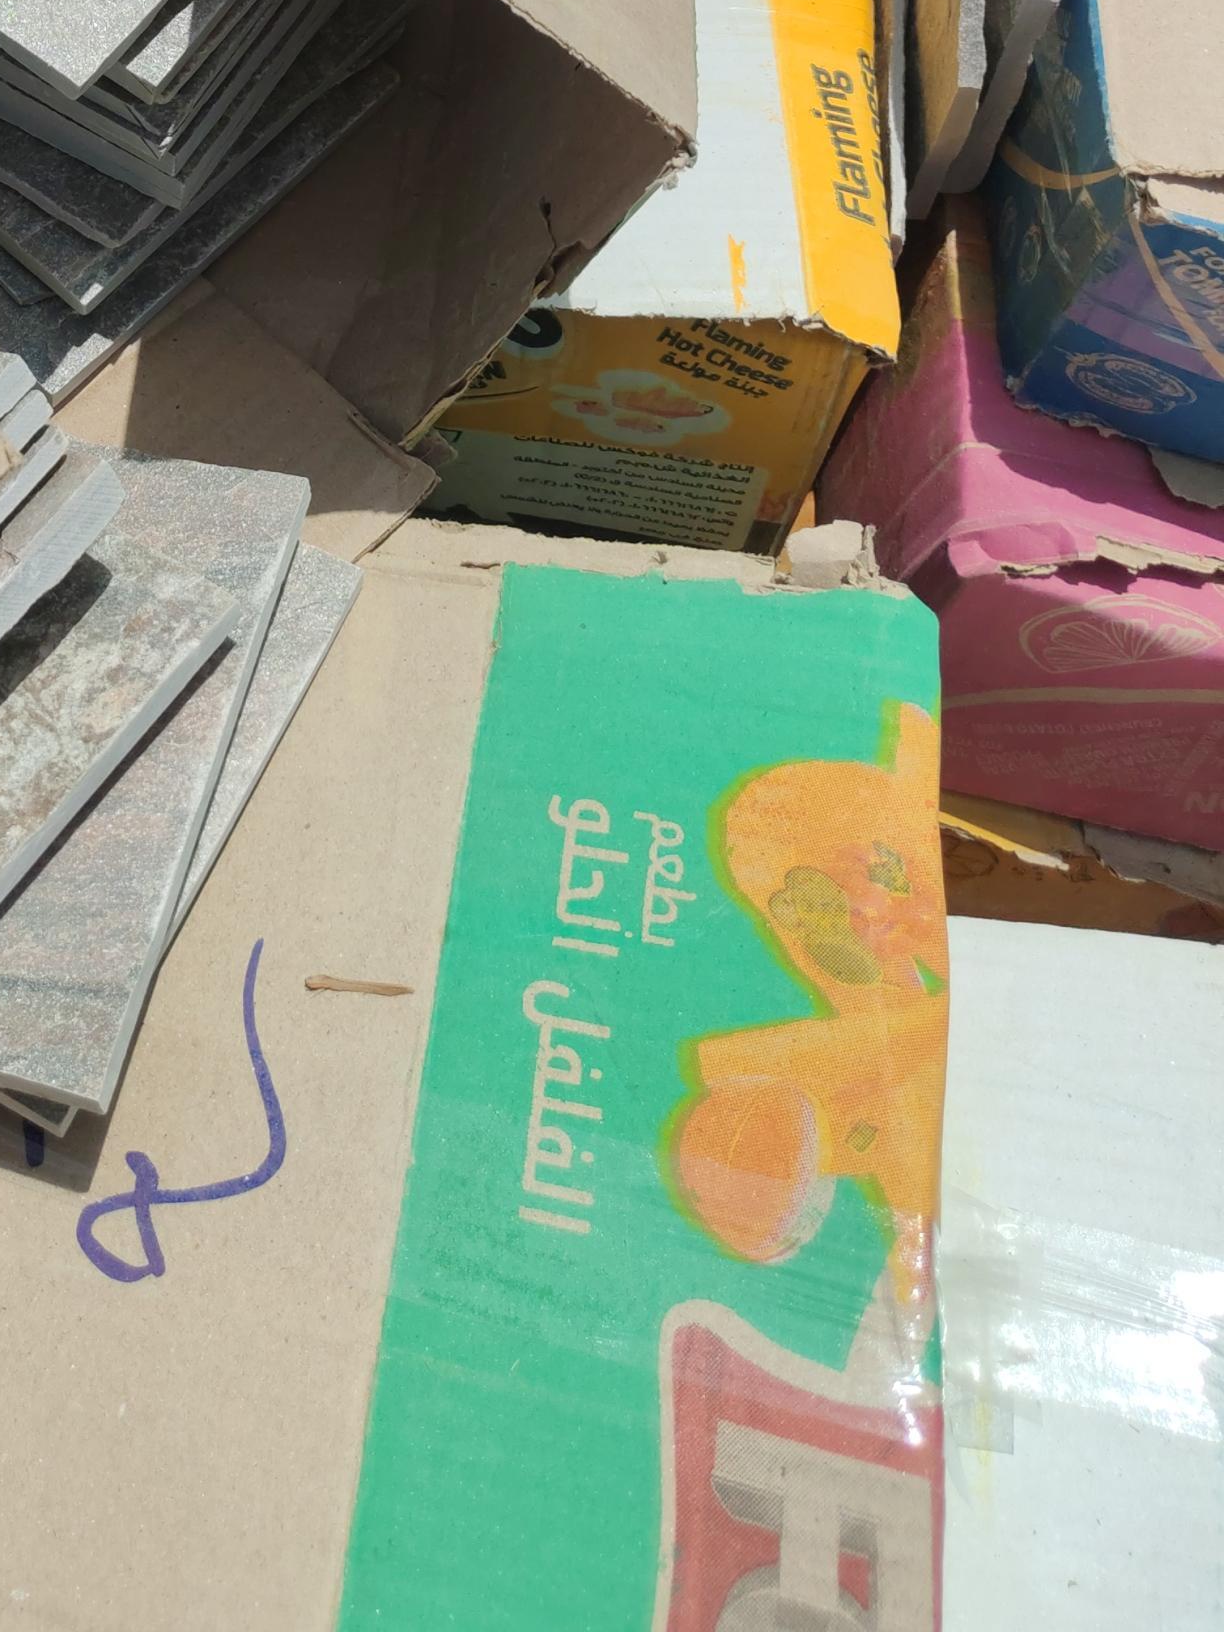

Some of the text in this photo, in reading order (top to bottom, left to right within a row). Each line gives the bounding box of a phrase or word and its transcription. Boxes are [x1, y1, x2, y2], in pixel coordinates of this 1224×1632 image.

[811, 63, 876, 226] Flaming
[656, 326, 794, 391] Hot Cheese
[690, 317, 793, 372] Flaming
[624, 809, 698, 948] بطعم
[518, 793, 631, 1236] الفلفل الحلو
